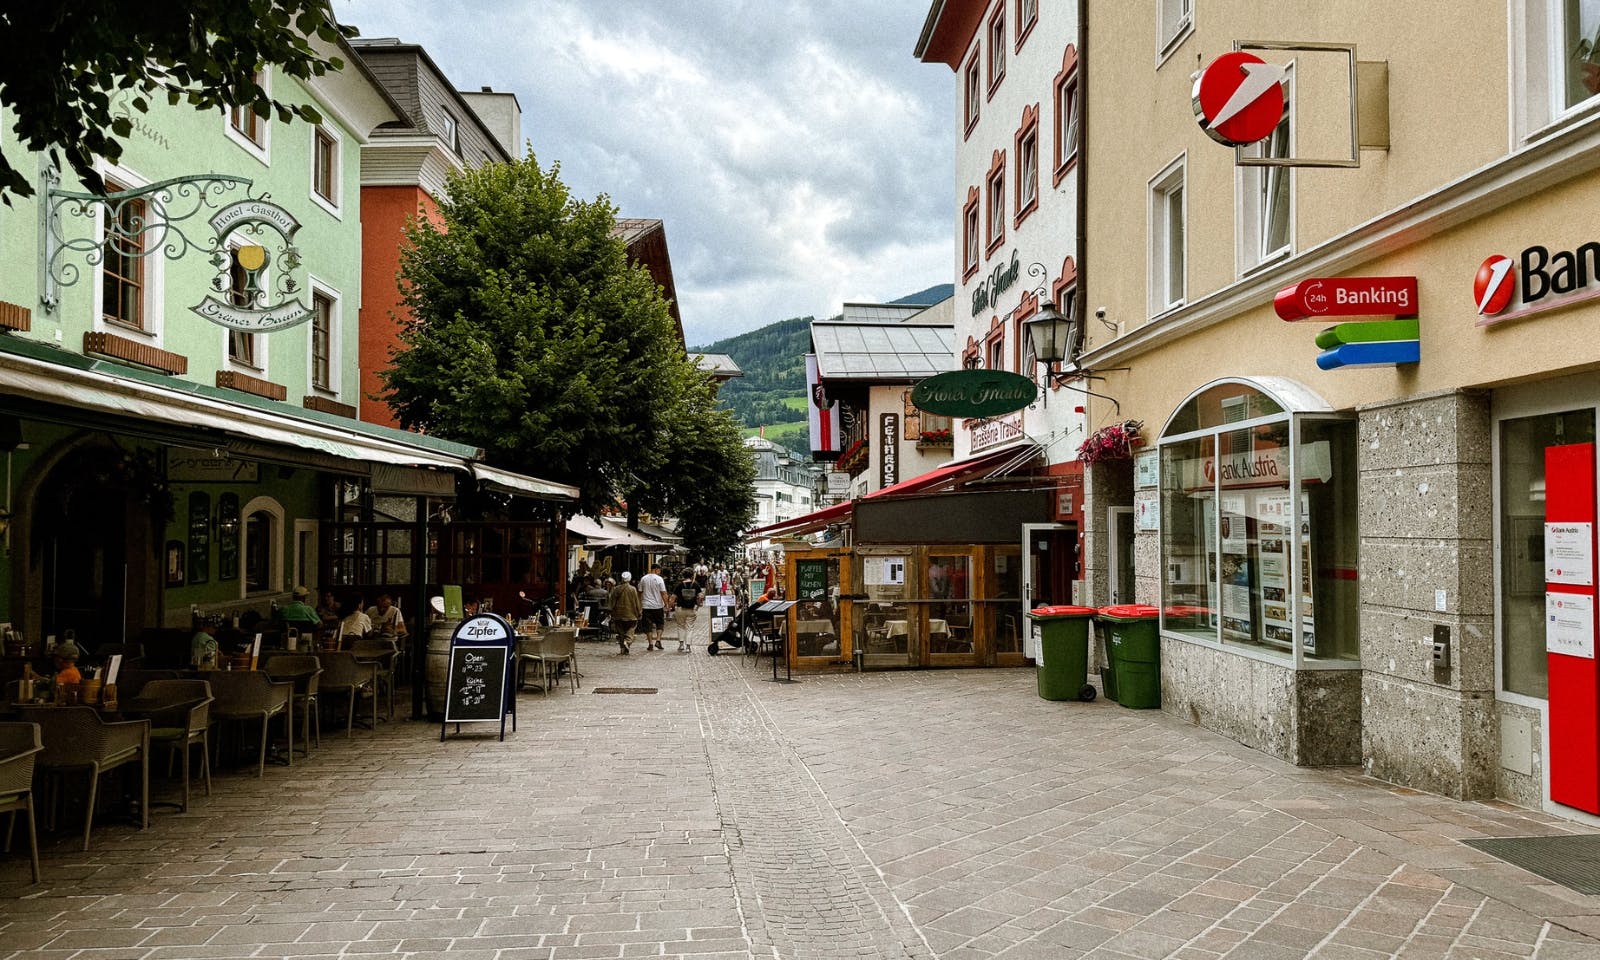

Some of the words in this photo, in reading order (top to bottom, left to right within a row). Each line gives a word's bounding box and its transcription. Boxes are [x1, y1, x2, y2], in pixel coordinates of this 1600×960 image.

[215, 206, 243, 229] Hotel
[1310, 294, 1327, 302] 24h
[1336, 286, 1408, 307] Banking
[257, 309, 303, 327] Baum
[1001, 417, 1021, 440] Traube
[1220, 459, 1241, 480] ank
[1242, 455, 1278, 478] Austria
[467, 627, 498, 639] Zipfer
